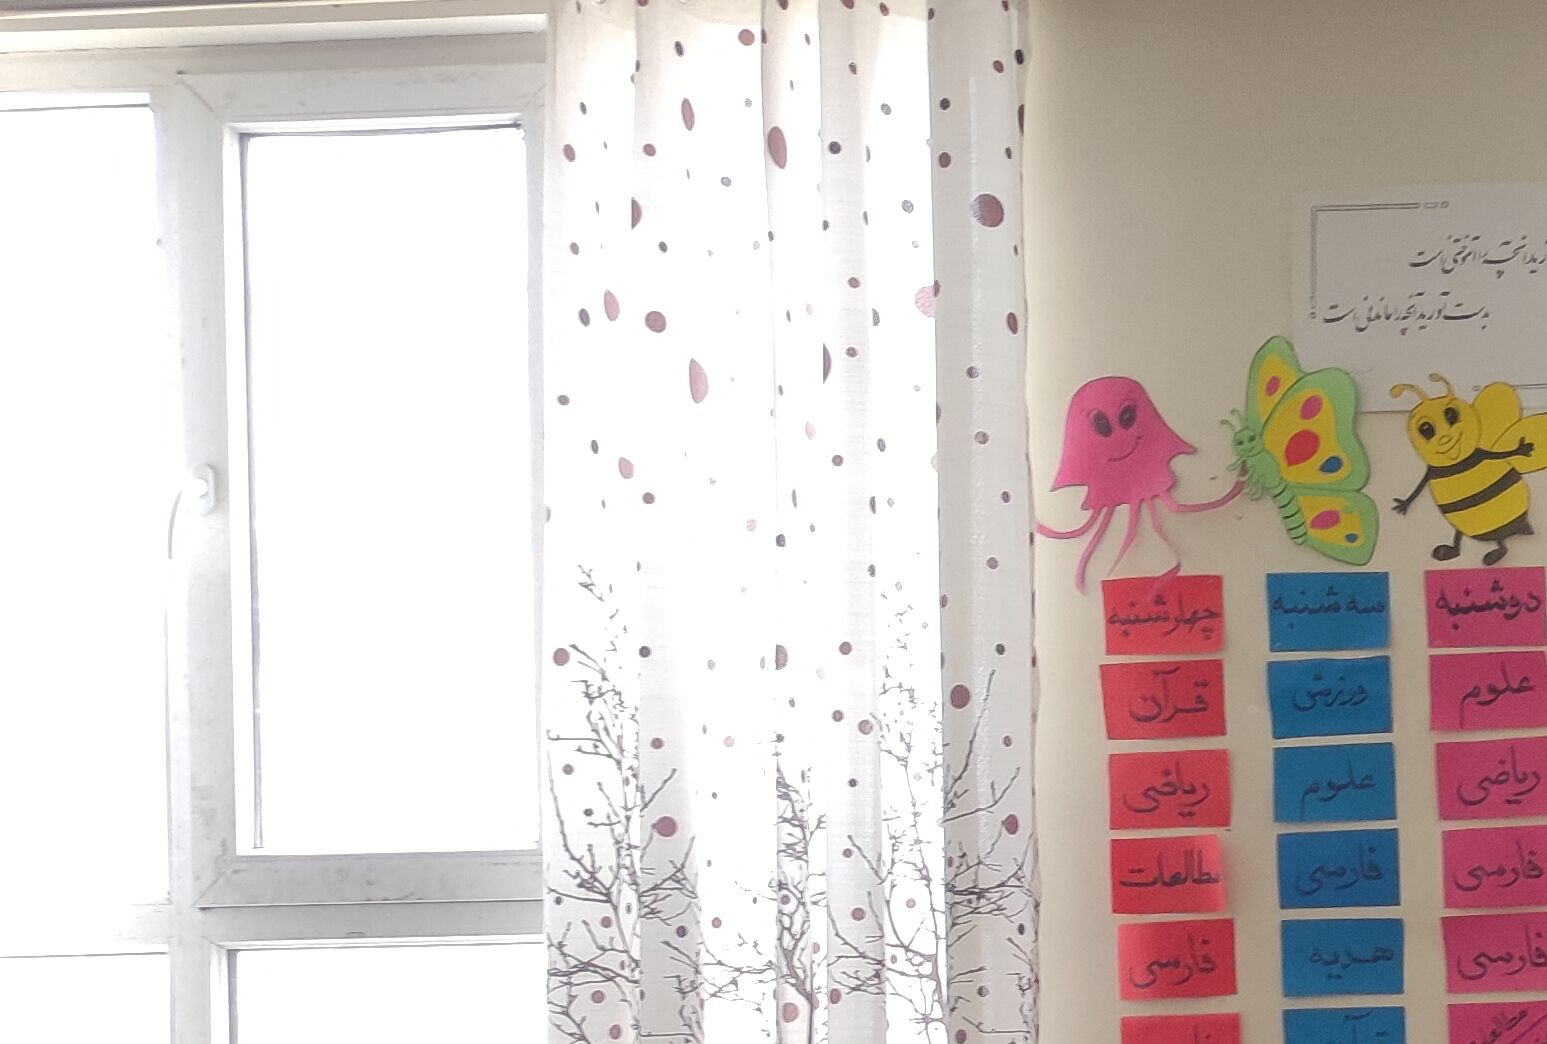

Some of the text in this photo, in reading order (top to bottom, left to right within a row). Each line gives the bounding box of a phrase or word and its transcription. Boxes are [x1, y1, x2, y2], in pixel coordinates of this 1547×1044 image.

[1273, 586, 1385, 629] سه شنبه
[1435, 579, 1540, 631] دوشنبه
[1129, 667, 1209, 723] قرآن
[1292, 674, 1368, 712] ورزش
[1459, 663, 1536, 730] علوم
[1123, 761, 1210, 818] ریاضی
[1300, 759, 1376, 821] علوم
[1457, 744, 1541, 807] ریاضی
[1296, 841, 1383, 897] فارسی
[1454, 838, 1545, 892] فارسی
[1129, 931, 1216, 989] فارسی
[1310, 942, 1394, 980] هدیه
